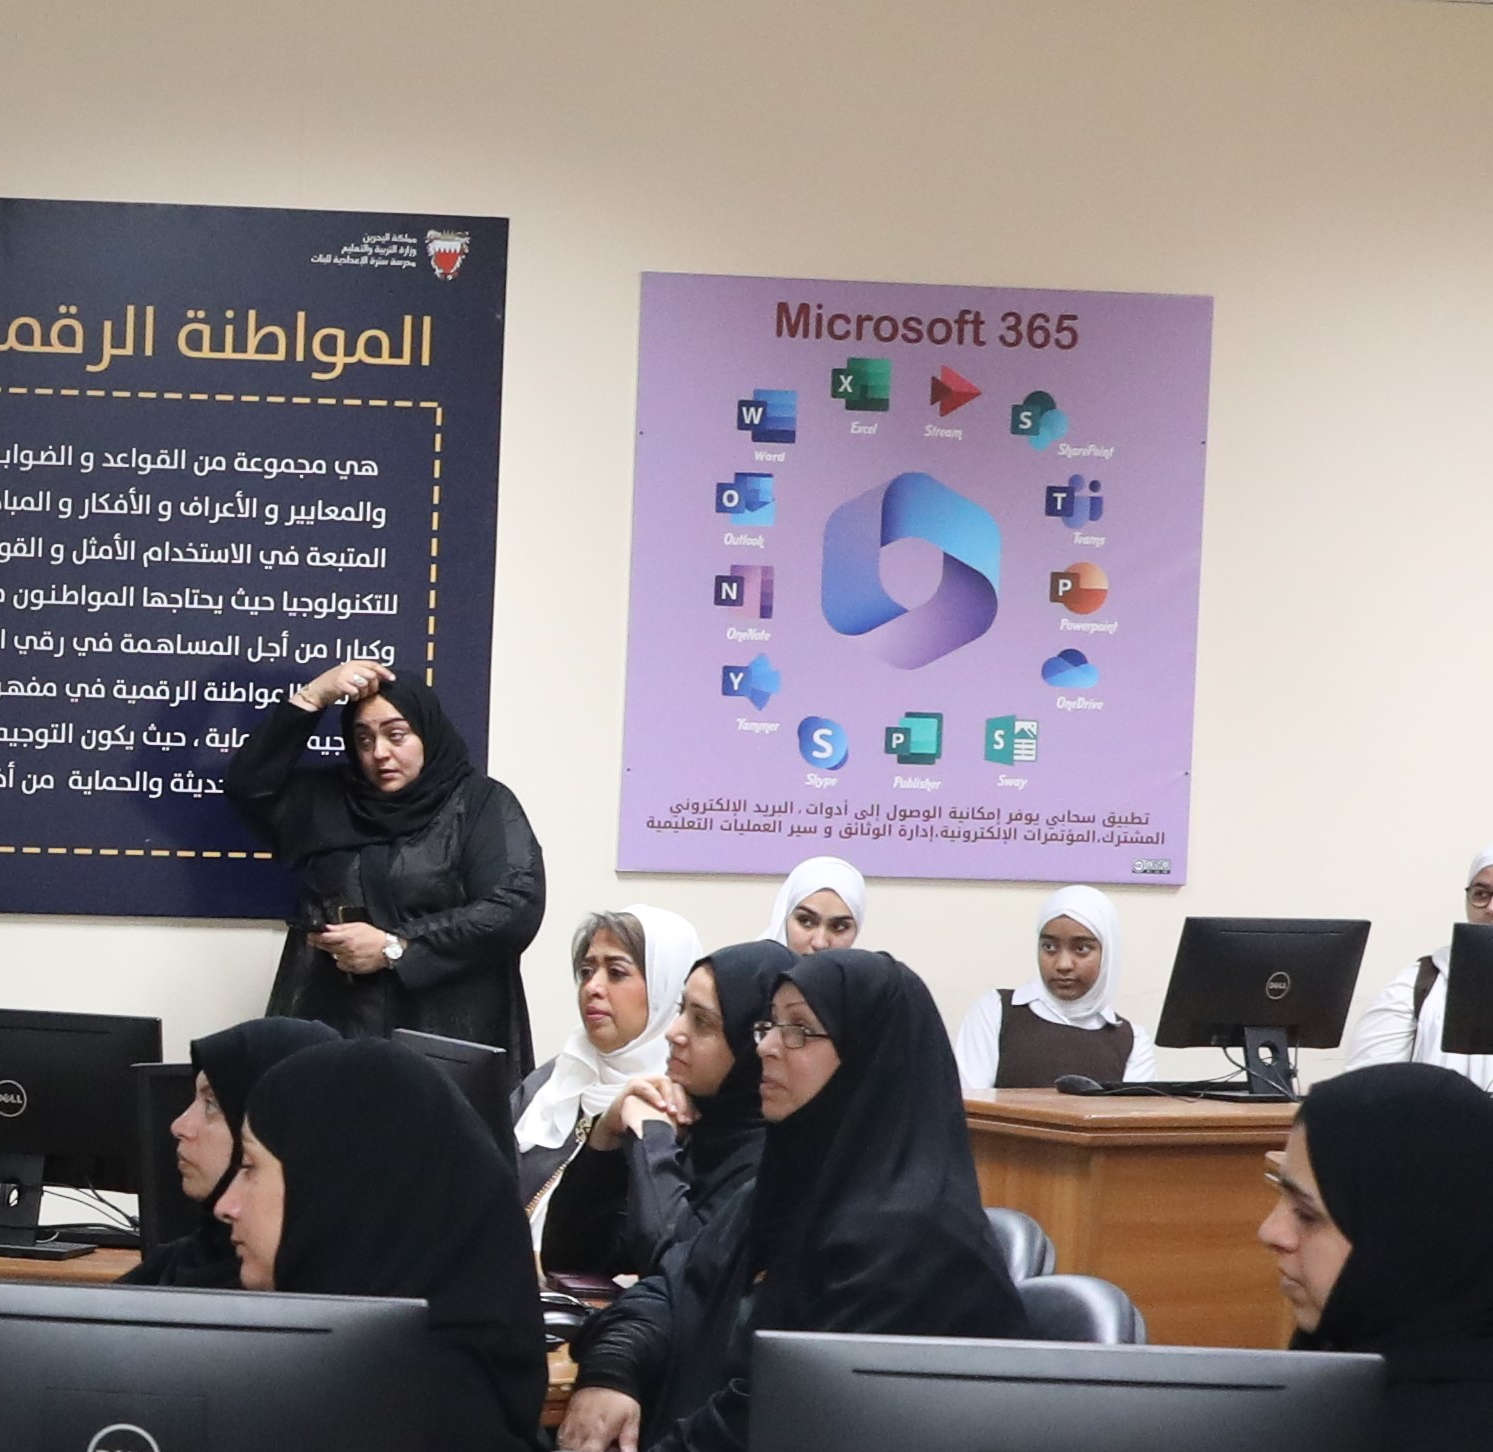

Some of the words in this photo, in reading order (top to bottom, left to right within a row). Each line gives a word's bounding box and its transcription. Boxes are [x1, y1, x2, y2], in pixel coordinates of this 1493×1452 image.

[776, 302, 986, 346] Microsoft
[999, 312, 1078, 350] 365
[178, 310, 432, 380] المواطنة
[850, 420, 878, 436] Excel
[924, 424, 964, 440] Stream
[79, 452, 95, 471] و
[102, 448, 186, 474] القواعد
[754, 449, 785, 463] Word
[1058, 443, 1114, 460] SharePoint
[194, 456, 226, 476] من
[234, 452, 326, 479] مجموعة
[335, 461, 378, 480] هي
[59, 498, 72, 518] و
[79, 487, 150, 519] الأفكار
[158, 501, 171, 521] و
[180, 491, 257, 523] الأعراف
[265, 504, 278, 525] و
[284, 500, 386, 528] والمعايير
[72, 533, 135, 564] الأمثل
[724, 533, 764, 548] Outlook
[1073, 532, 1106, 547] Teams
[51, 544, 64, 564] و
[143, 541, 251, 567] الاستخدام
[258, 548, 299, 571] في
[307, 547, 386, 572] المتبعة
[13, 584, 134, 612] المواطنون
[143, 587, 223, 614] يحتاجها
[231, 588, 274, 615] حيث
[283, 591, 397, 619] للتكنولوجيا
[727, 627, 771, 642] OneNote
[1060, 617, 1118, 634] Powerpoint
[14, 631, 64, 657] رقي
[73, 632, 112, 656] في
[121, 634, 239, 655] المساهمة
[248, 631, 289, 662] أجل
[294, 640, 328, 663] من
[335, 639, 396, 667] وكبارا
[66, 678, 105, 702] في
[113, 680, 196, 706] الرقمية
[1056, 697, 1104, 712] OneDrive
[736, 718, 780, 735] Yammer
[81, 725, 134, 751] يكون
[143, 724, 186, 751] حيث
[22, 774, 54, 794] من
[69, 770, 162, 798] والحماية
[805, 773, 838, 788] Skype
[893, 776, 941, 791] Publisher
[997, 775, 1028, 790] Sway
[670, 798, 746, 817] الإلكتروني
[753, 801, 793, 817] البريد
[855, 804, 879, 821] إلى
[887, 805, 941, 822] الوصول
[949, 806, 1000, 825] إمكانية
[1006, 810, 1039, 824] يوفر
[647, 815, 713, 833] التعليمية
[720, 819, 782, 835] العمليات
[787, 822, 817, 837] سير
[1046, 810, 1095, 829] سحابي
[1102, 812, 1149, 828] تطبيق
[824, 826, 832, 838] و
[839, 822, 892, 840] الوثائق
